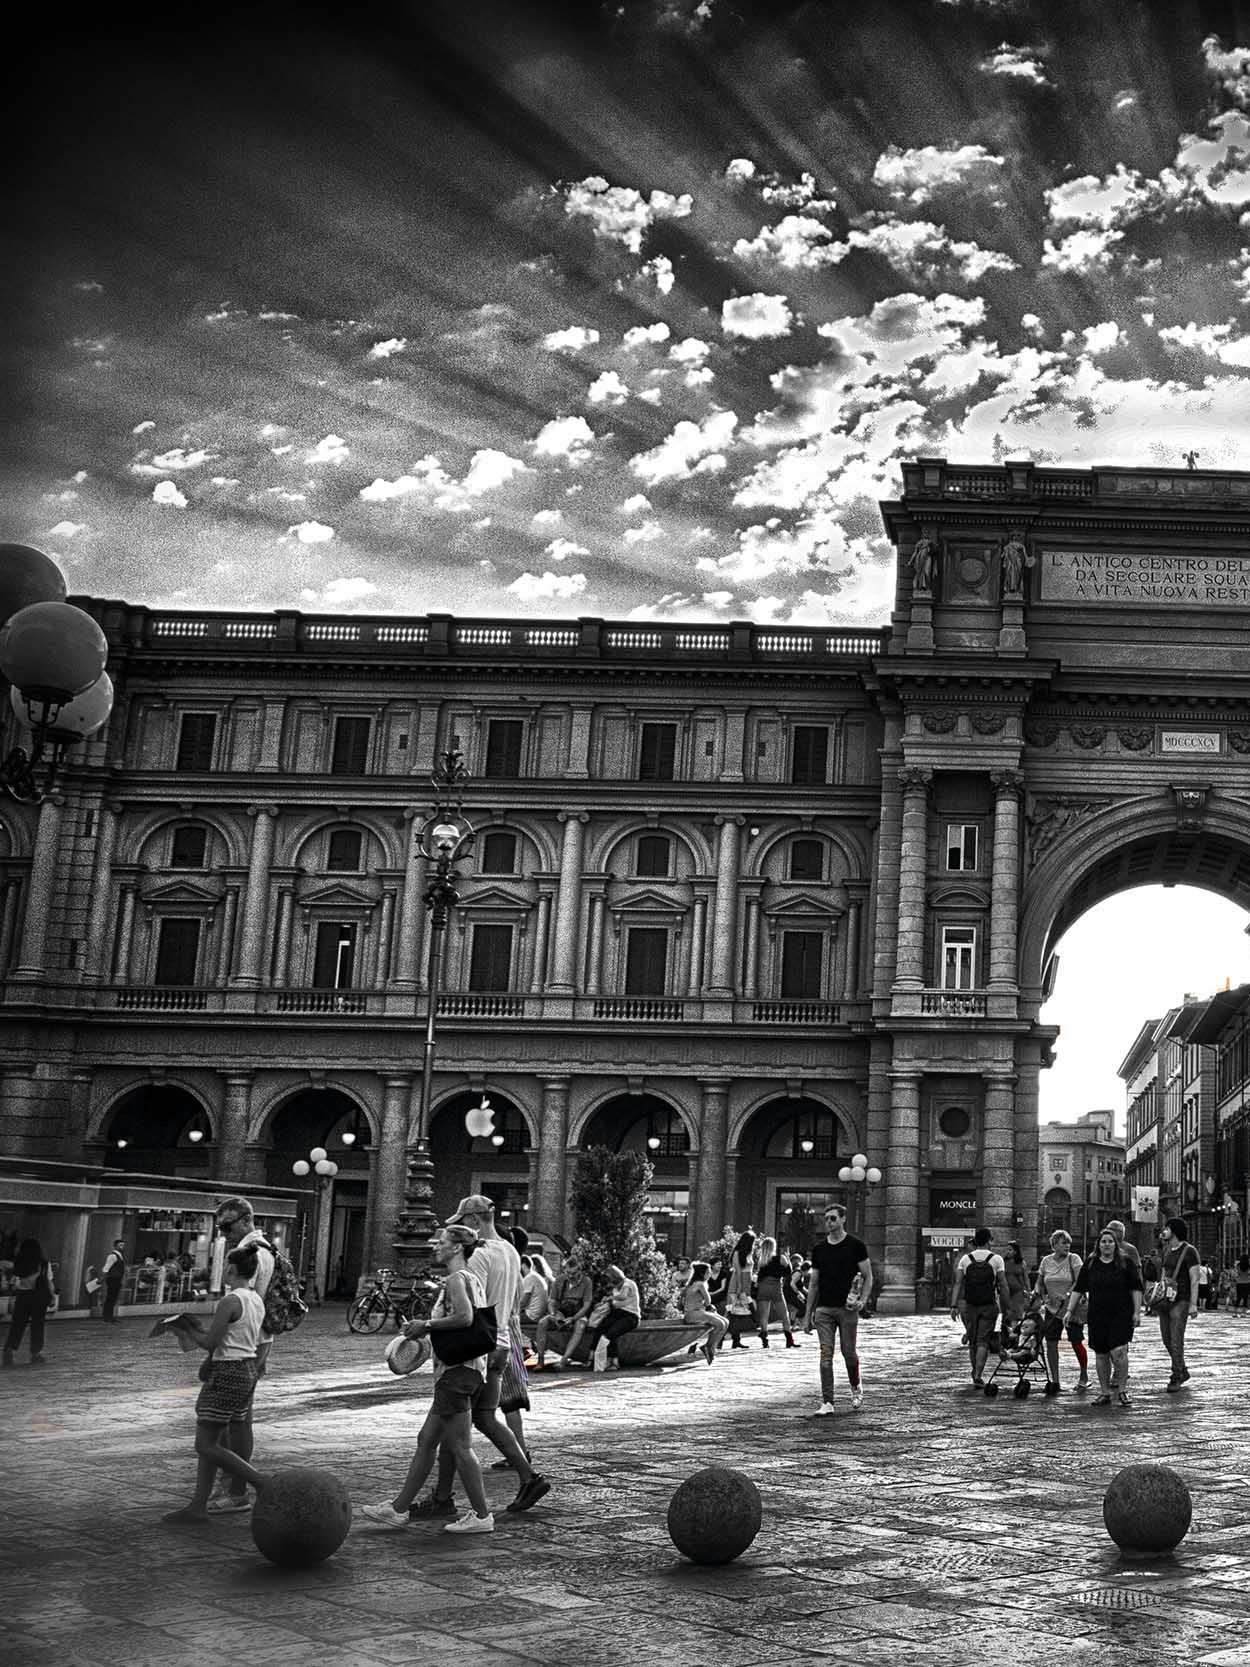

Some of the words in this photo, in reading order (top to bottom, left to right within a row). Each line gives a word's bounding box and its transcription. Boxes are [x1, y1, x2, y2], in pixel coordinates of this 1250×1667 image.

[1071, 556, 1132, 568] ANTICO
[1139, 558, 1208, 570] CENTRO
[1076, 570, 1098, 582] DA
[1105, 571, 1196, 584] SECOLARE
[1076, 584, 1085, 595] A
[1094, 584, 1133, 596] VITA
[1140, 586, 1198, 598] NUOVA
[1165, 736, 1216, 748] MDCCCXCV
[932, 1237, 963, 1246] VOGUE
